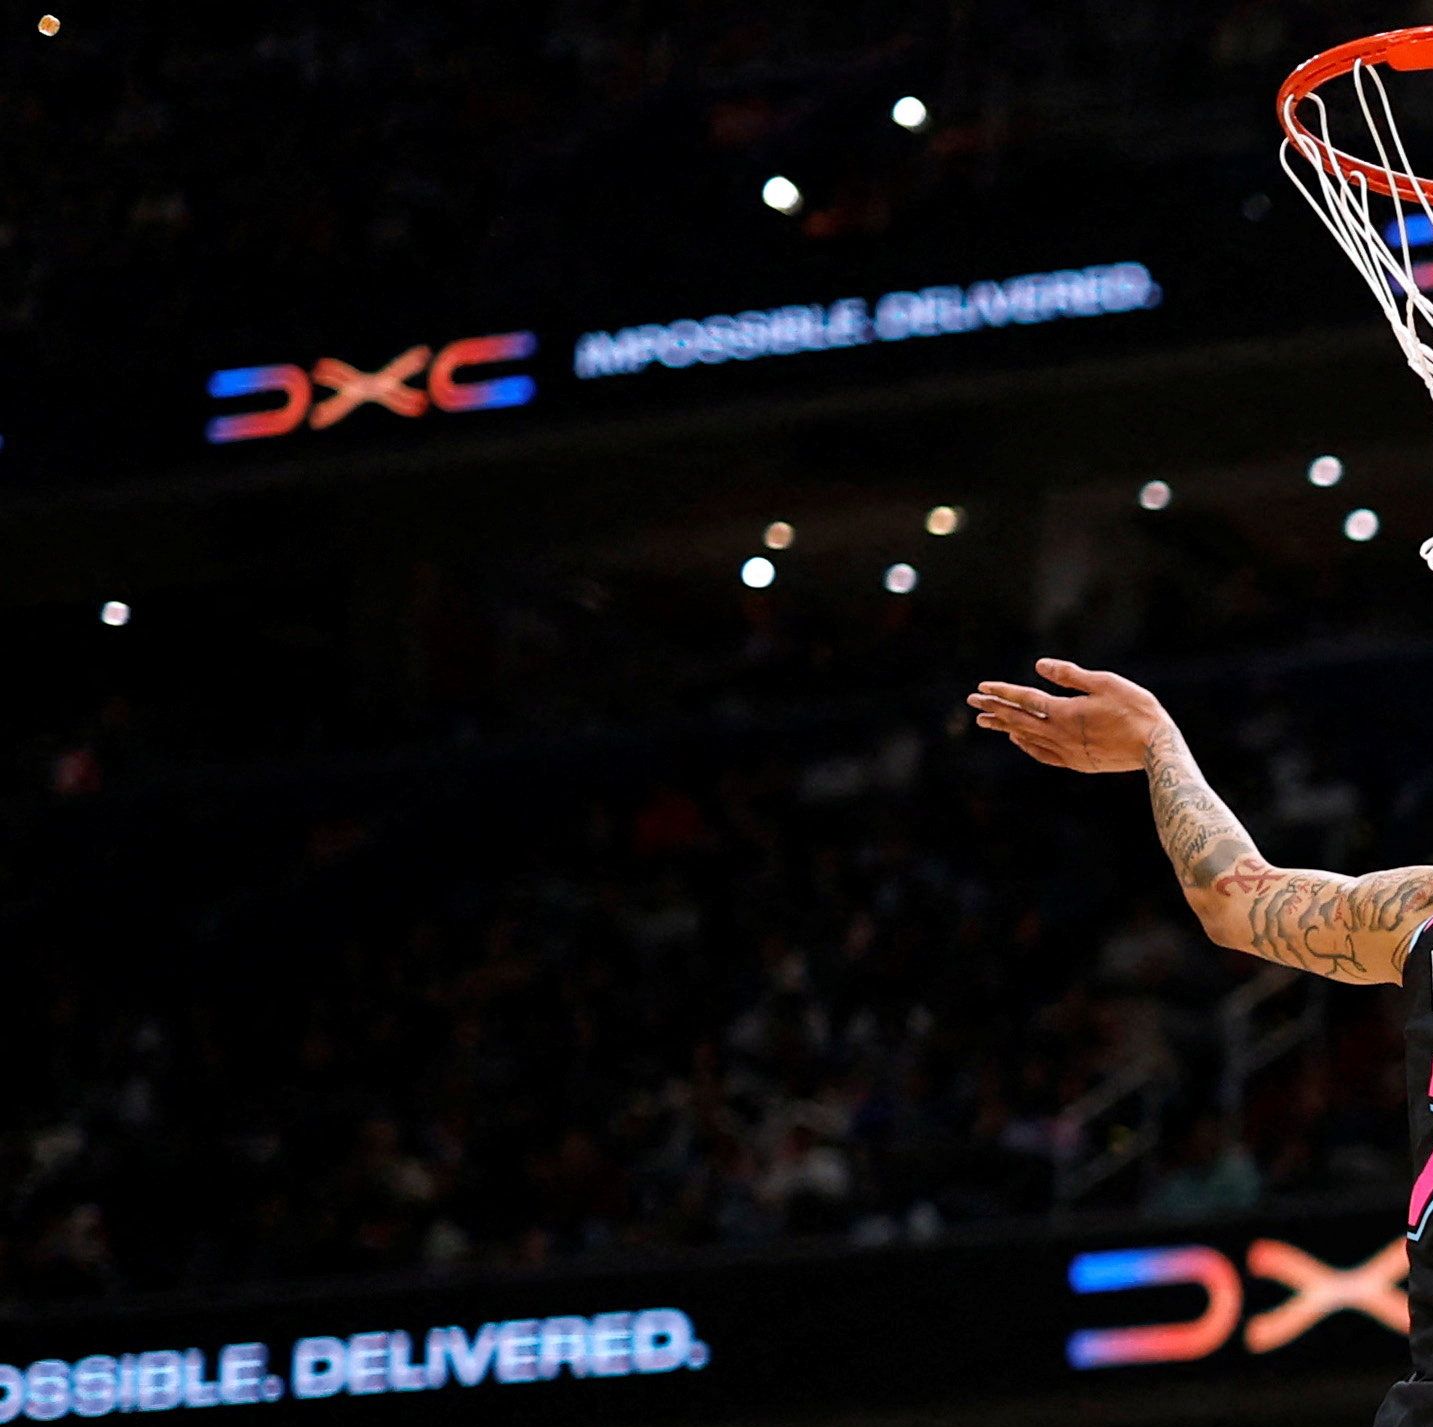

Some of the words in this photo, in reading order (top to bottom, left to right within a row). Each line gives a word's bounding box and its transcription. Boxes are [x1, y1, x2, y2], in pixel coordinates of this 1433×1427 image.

[206, 331, 537, 444] DXC
[291, 1307, 711, 1400] DELIVERED.
[1066, 1238, 1412, 1370] DX
